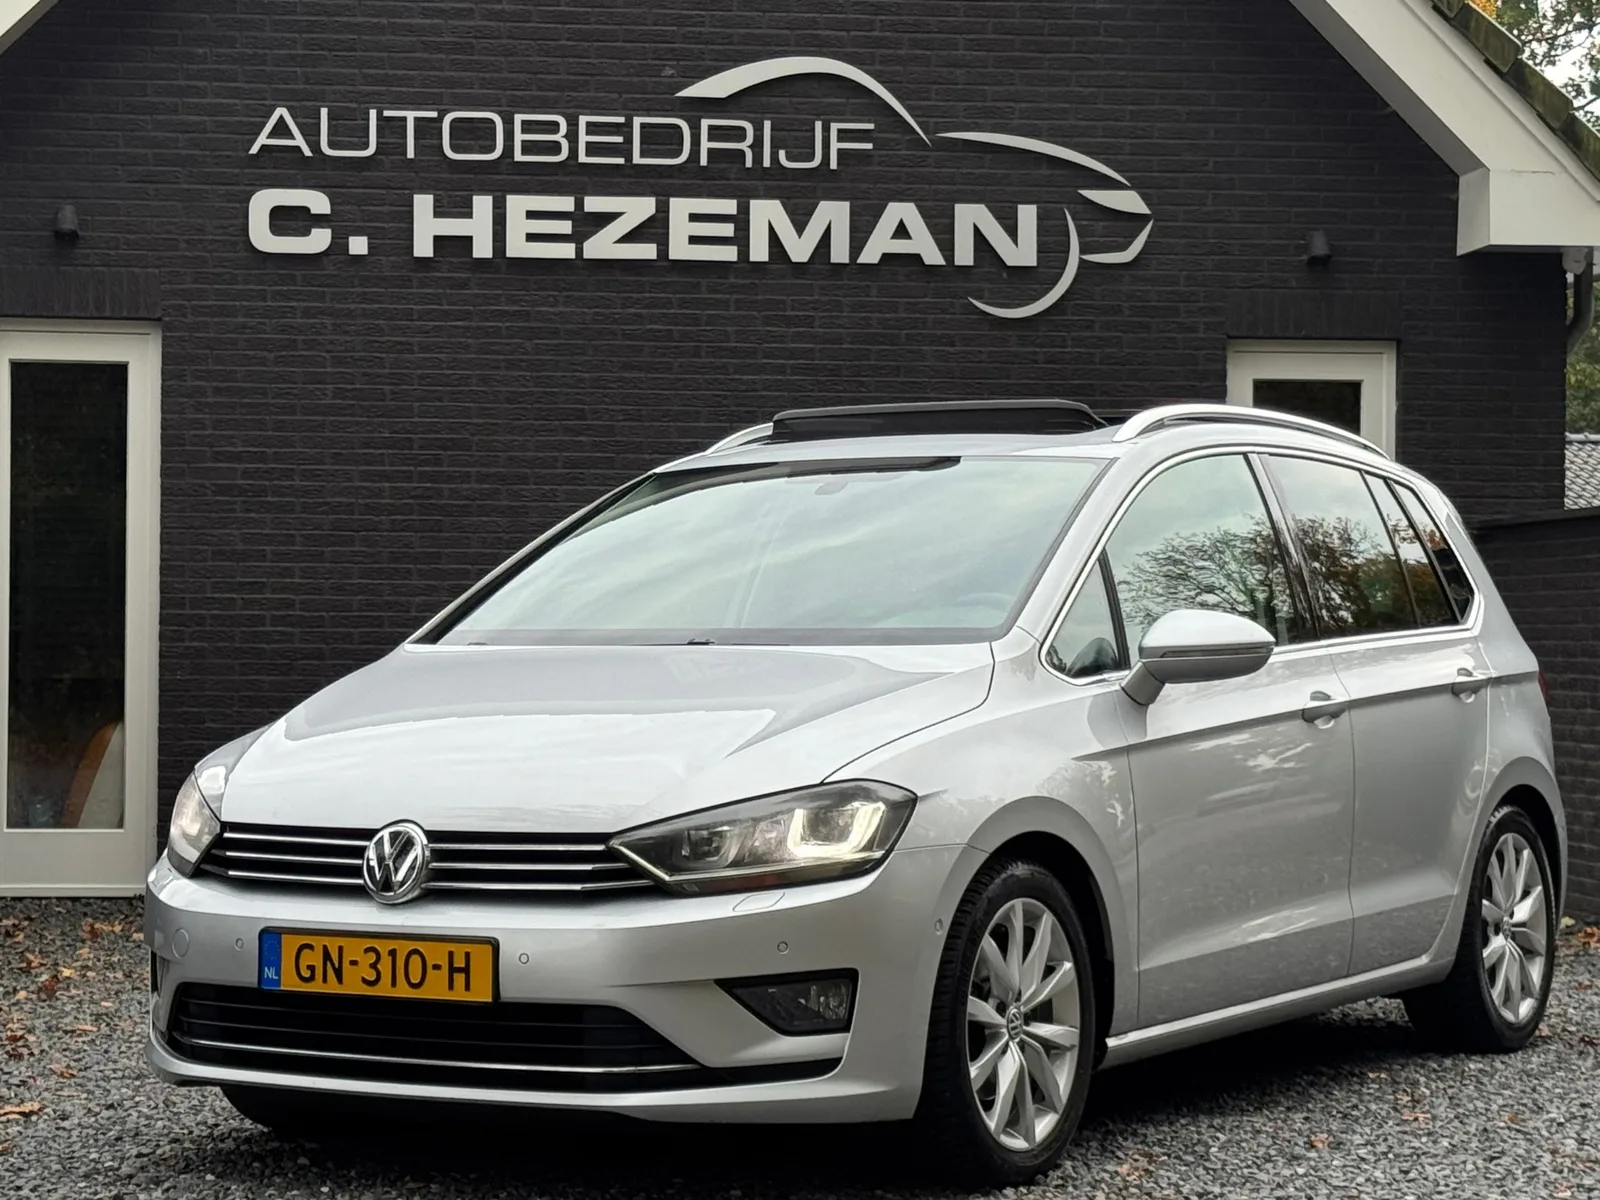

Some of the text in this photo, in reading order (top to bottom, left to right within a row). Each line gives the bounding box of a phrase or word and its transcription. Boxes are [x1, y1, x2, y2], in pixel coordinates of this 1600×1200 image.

[248, 107, 875, 170] AUTOBEDRIJF
[248, 188, 1038, 268] C. HEZEMAN
[264, 966, 279, 980] NL
[293, 942, 472, 993] GN-310-H
